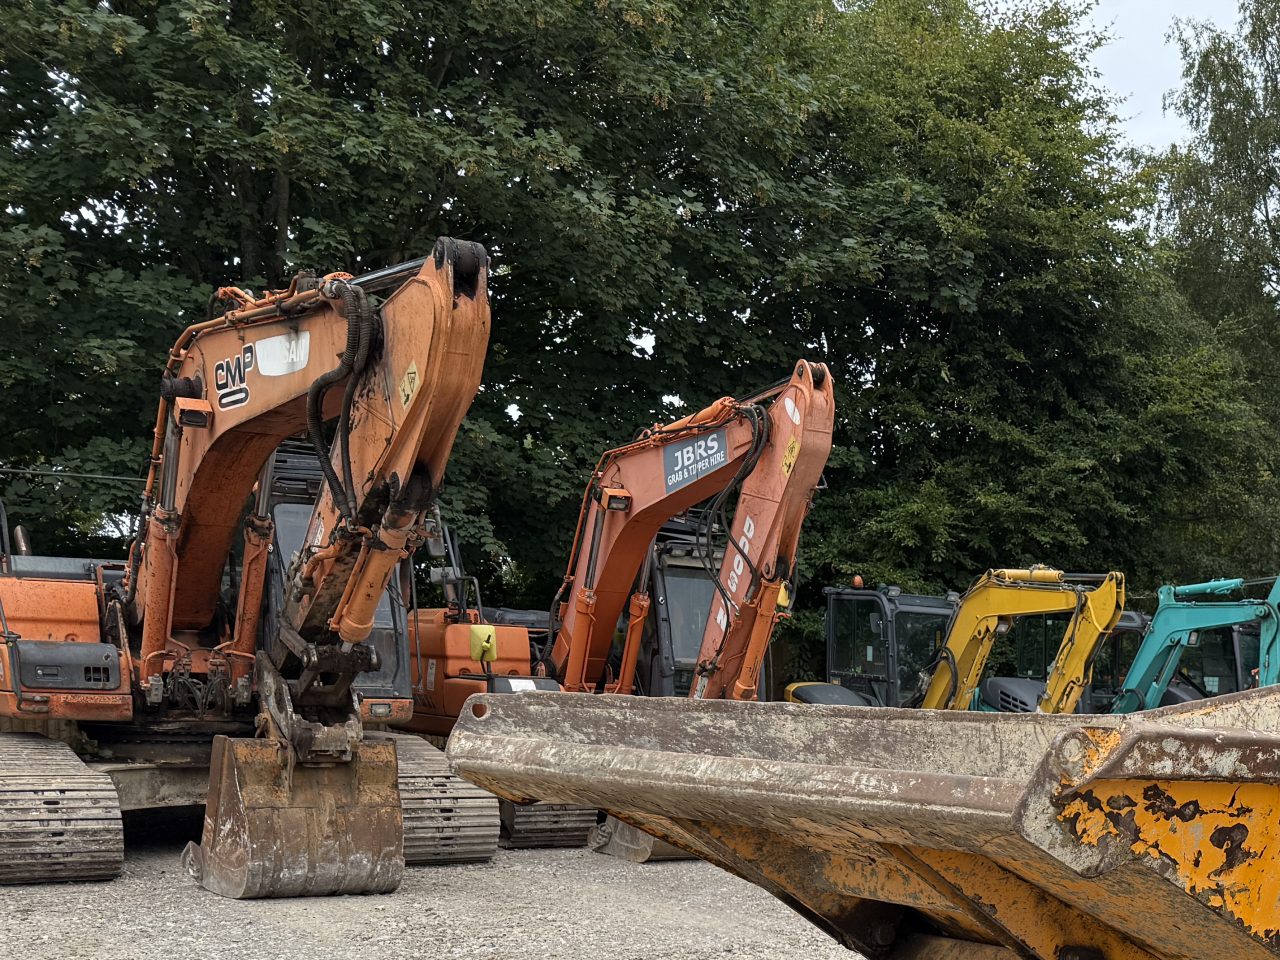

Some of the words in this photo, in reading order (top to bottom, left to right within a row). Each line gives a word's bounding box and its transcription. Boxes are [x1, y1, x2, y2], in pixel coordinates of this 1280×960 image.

[215, 343, 254, 392] CMP
[667, 470, 683, 486] GRAB
[683, 468, 689, 479] &
[710, 450, 725, 467] HIRE
[674, 433, 719, 471] JBRS
